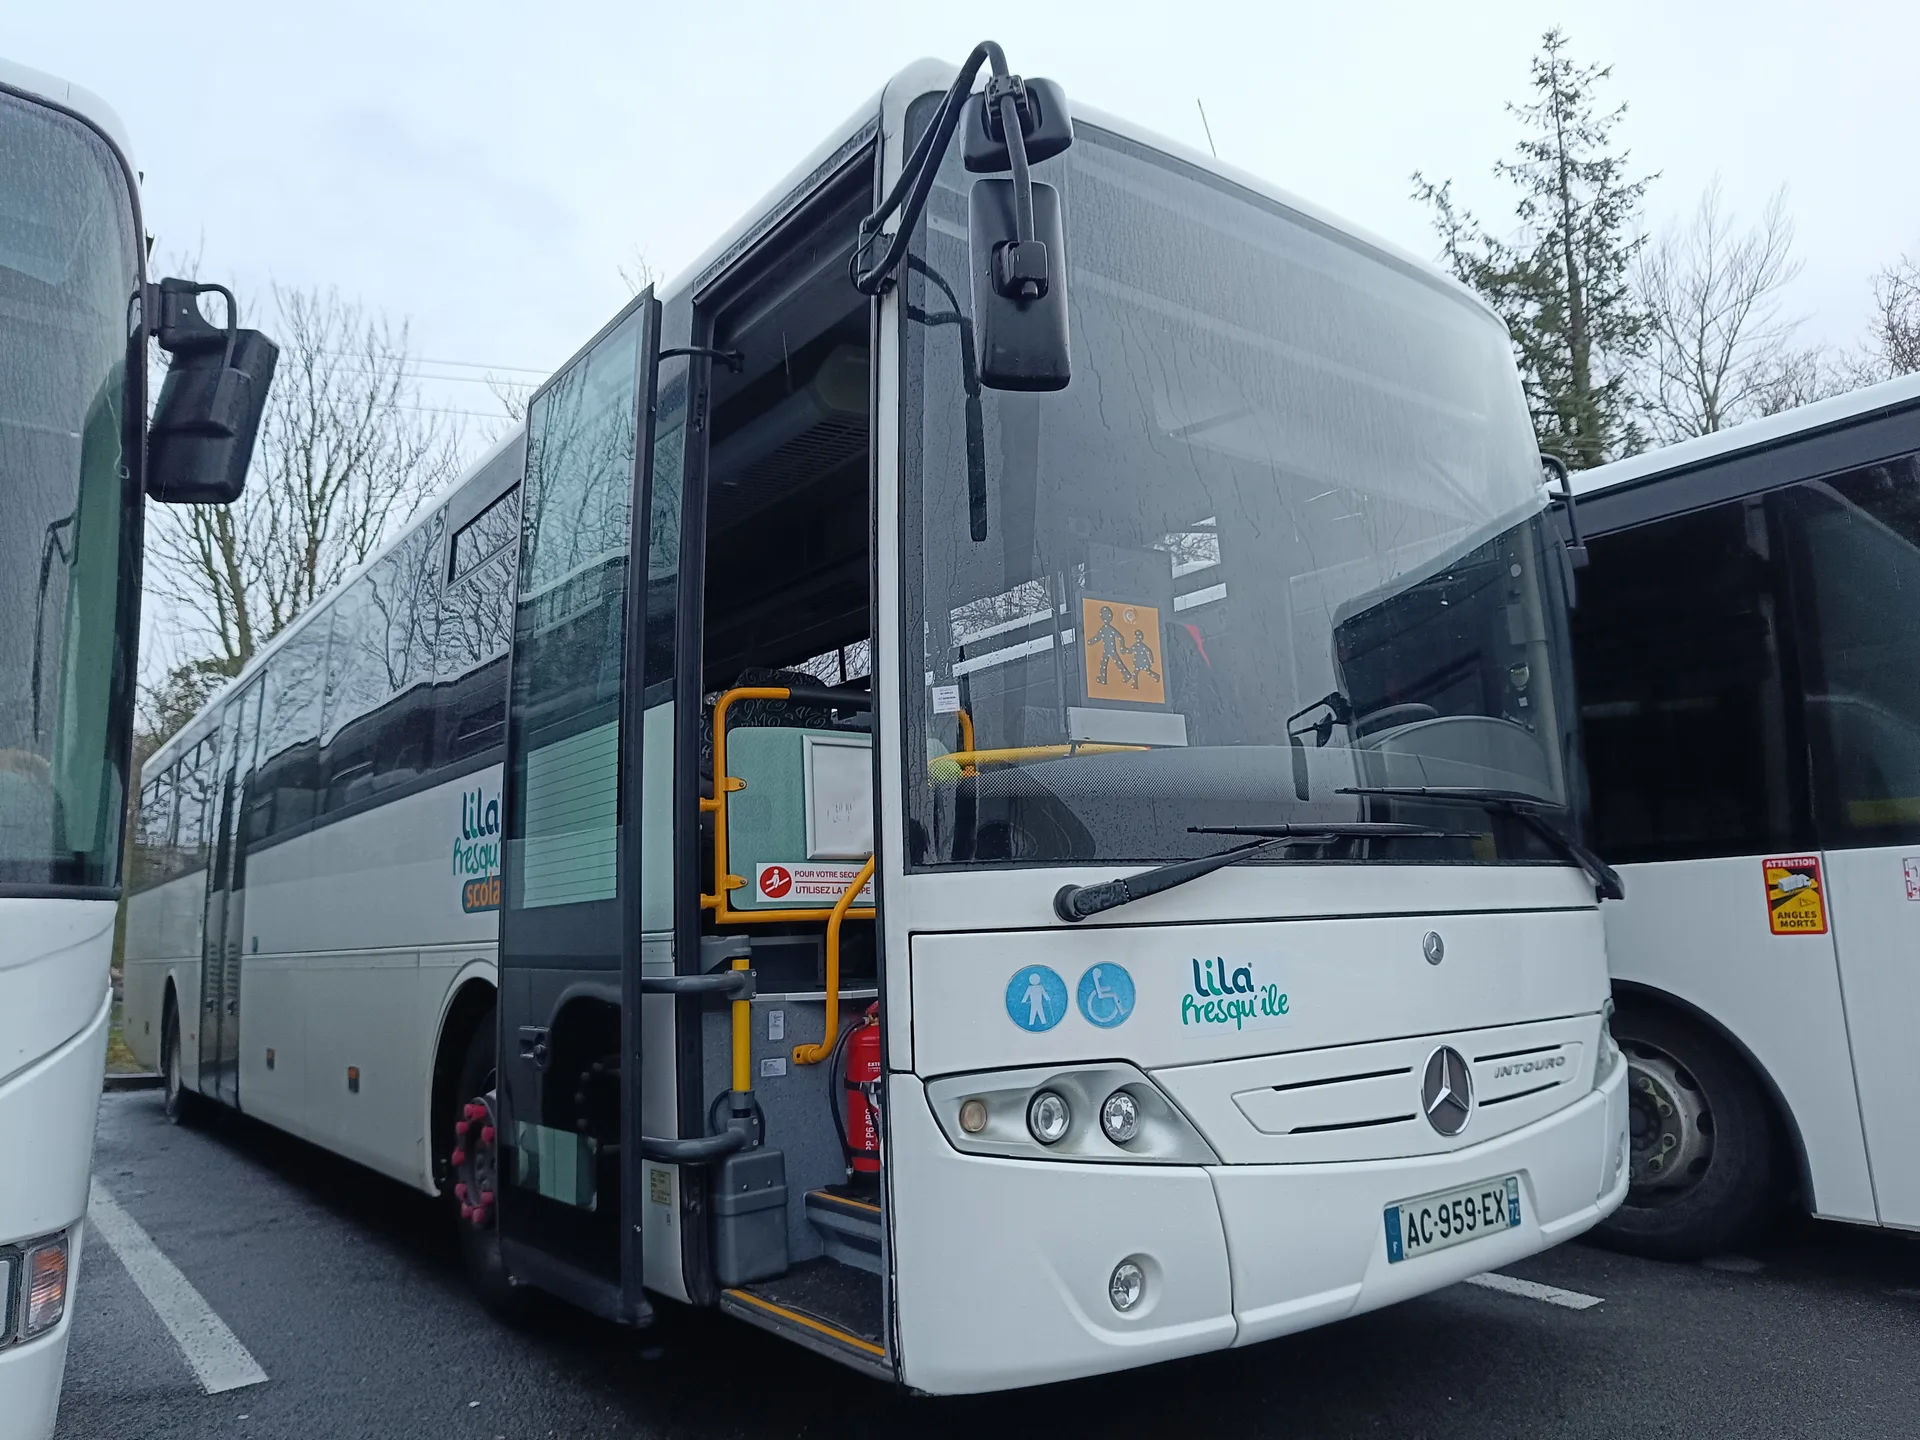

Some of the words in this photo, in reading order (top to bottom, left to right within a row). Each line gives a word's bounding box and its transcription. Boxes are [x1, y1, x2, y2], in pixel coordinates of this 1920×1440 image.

[1765, 858, 1816, 869] ATTENTION
[794, 870, 815, 878] POUR
[816, 870, 838, 878] VOTRE
[839, 871, 860, 879] SECU
[795, 886, 830, 895] UTILISEZ
[832, 886, 845, 894] LA
[1777, 910, 1817, 919] ANGLES
[1780, 919, 1816, 928] MORTS
[1494, 1056, 1566, 1078] INTOURO
[1508, 1203, 1520, 1220] 72
